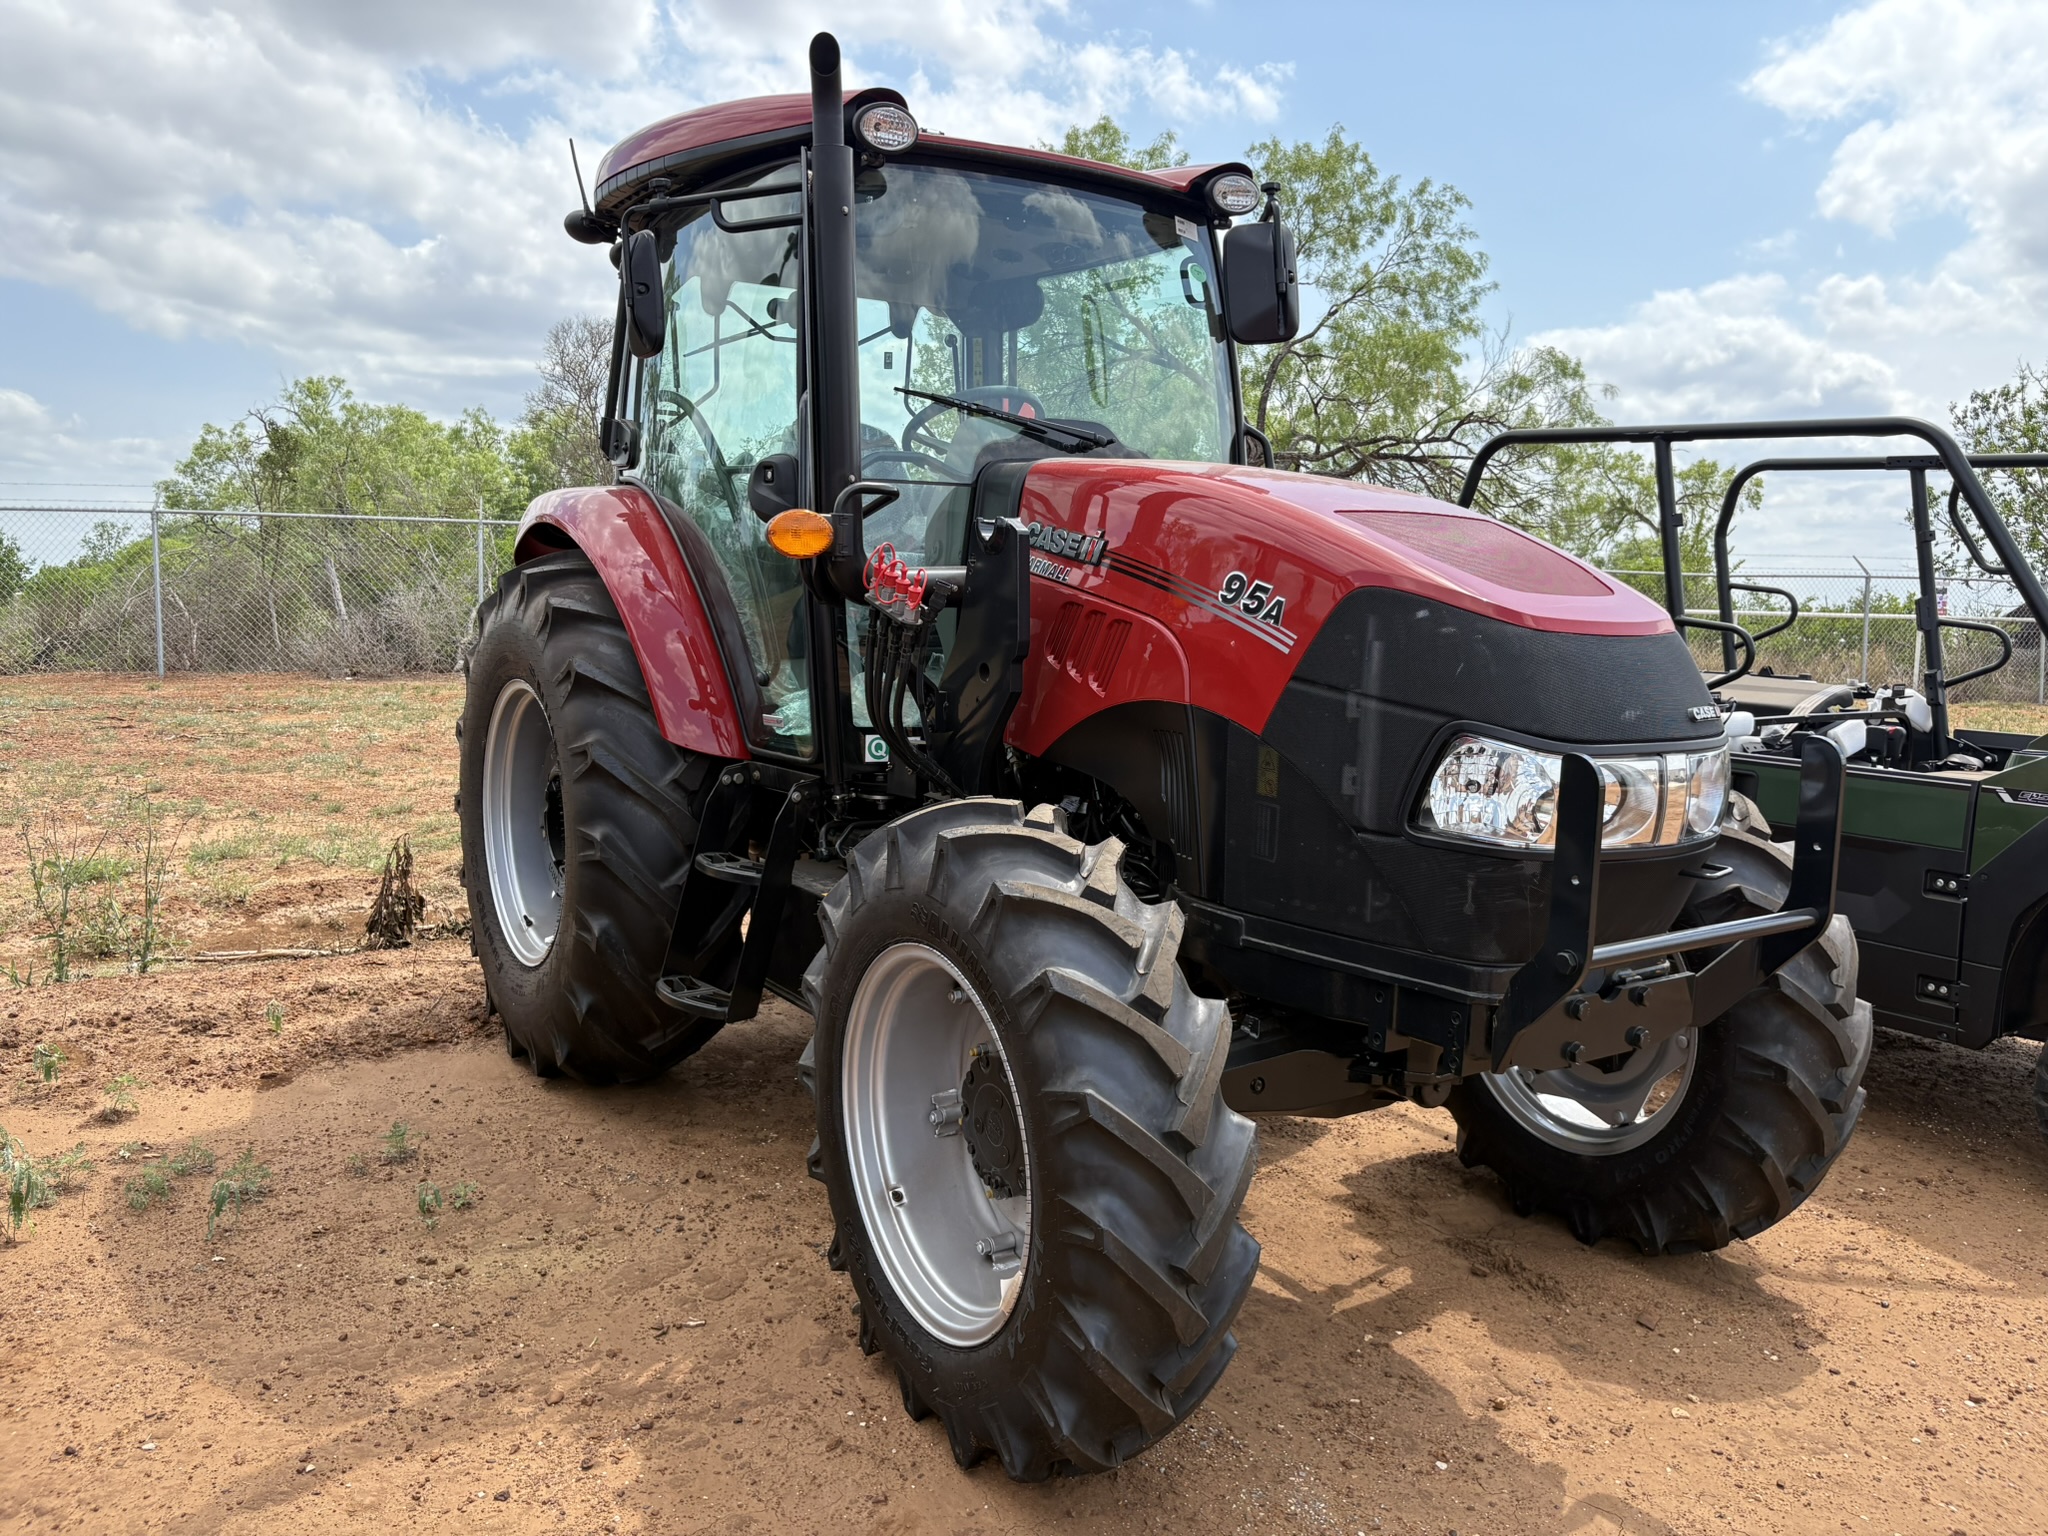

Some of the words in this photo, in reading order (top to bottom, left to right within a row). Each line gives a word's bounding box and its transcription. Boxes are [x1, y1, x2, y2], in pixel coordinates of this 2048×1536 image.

[1029, 555, 1071, 583] ARMALL
[1218, 571, 1286, 627] 95A
[1693, 706, 1716, 720] CASE
[871, 740, 887, 757] Q
[927, 910, 1013, 1031] ALLIANCE
